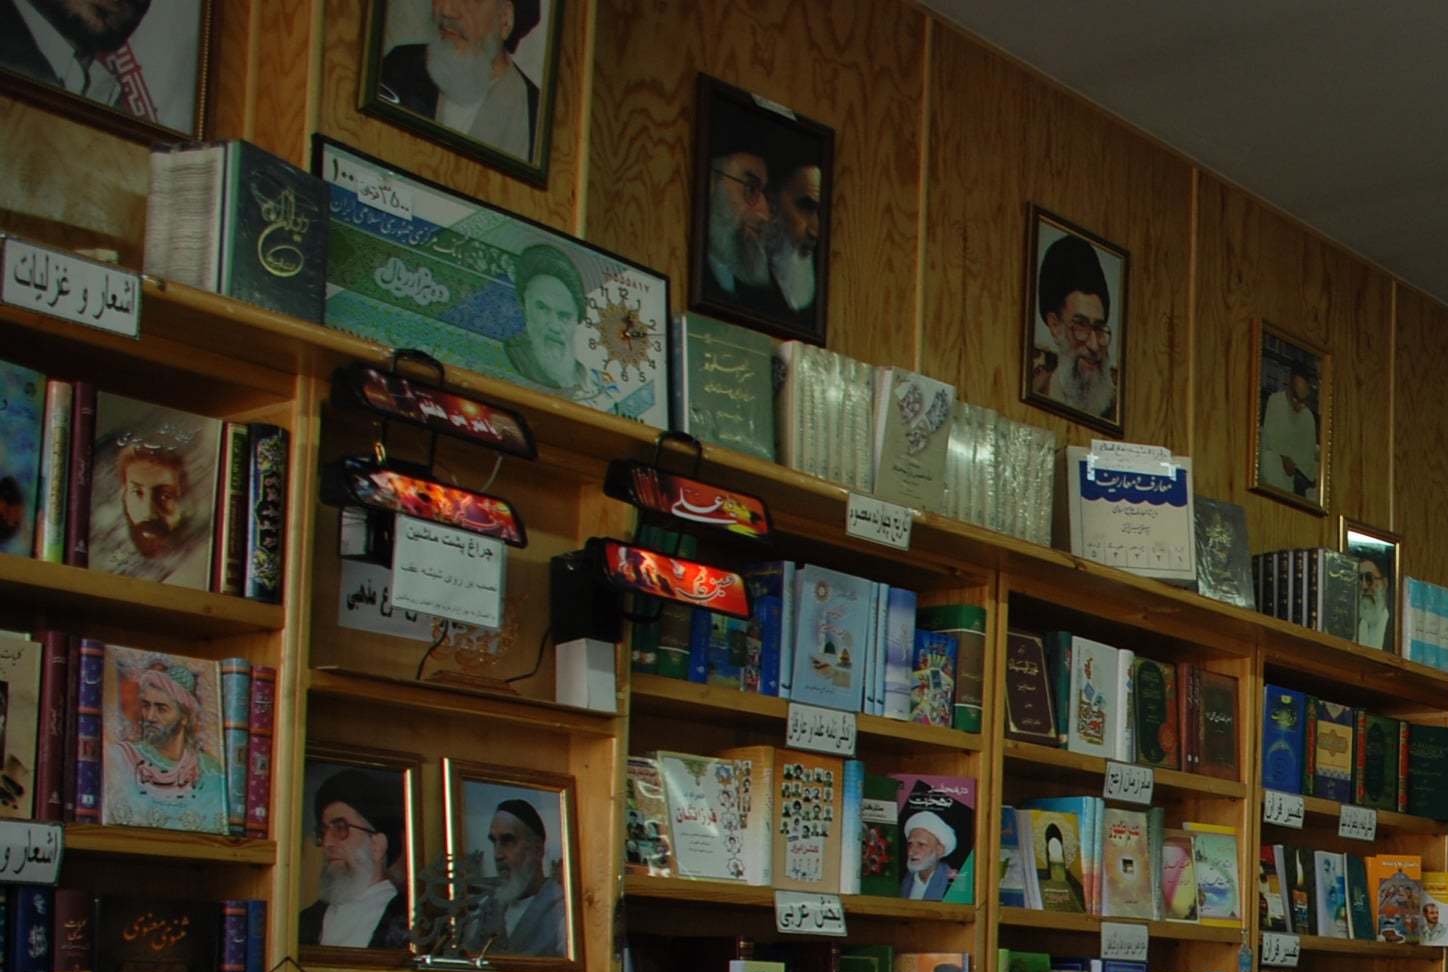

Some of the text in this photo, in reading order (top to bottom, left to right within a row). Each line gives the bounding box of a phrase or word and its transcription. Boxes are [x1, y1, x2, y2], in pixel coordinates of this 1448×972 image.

[13, 252, 137, 319] اشعار و غزلیات
[406, 525, 493, 559] چراغ پشت ماشین
[13, 829, 60, 877] اشعار
[780, 896, 843, 929] بخش عربی
